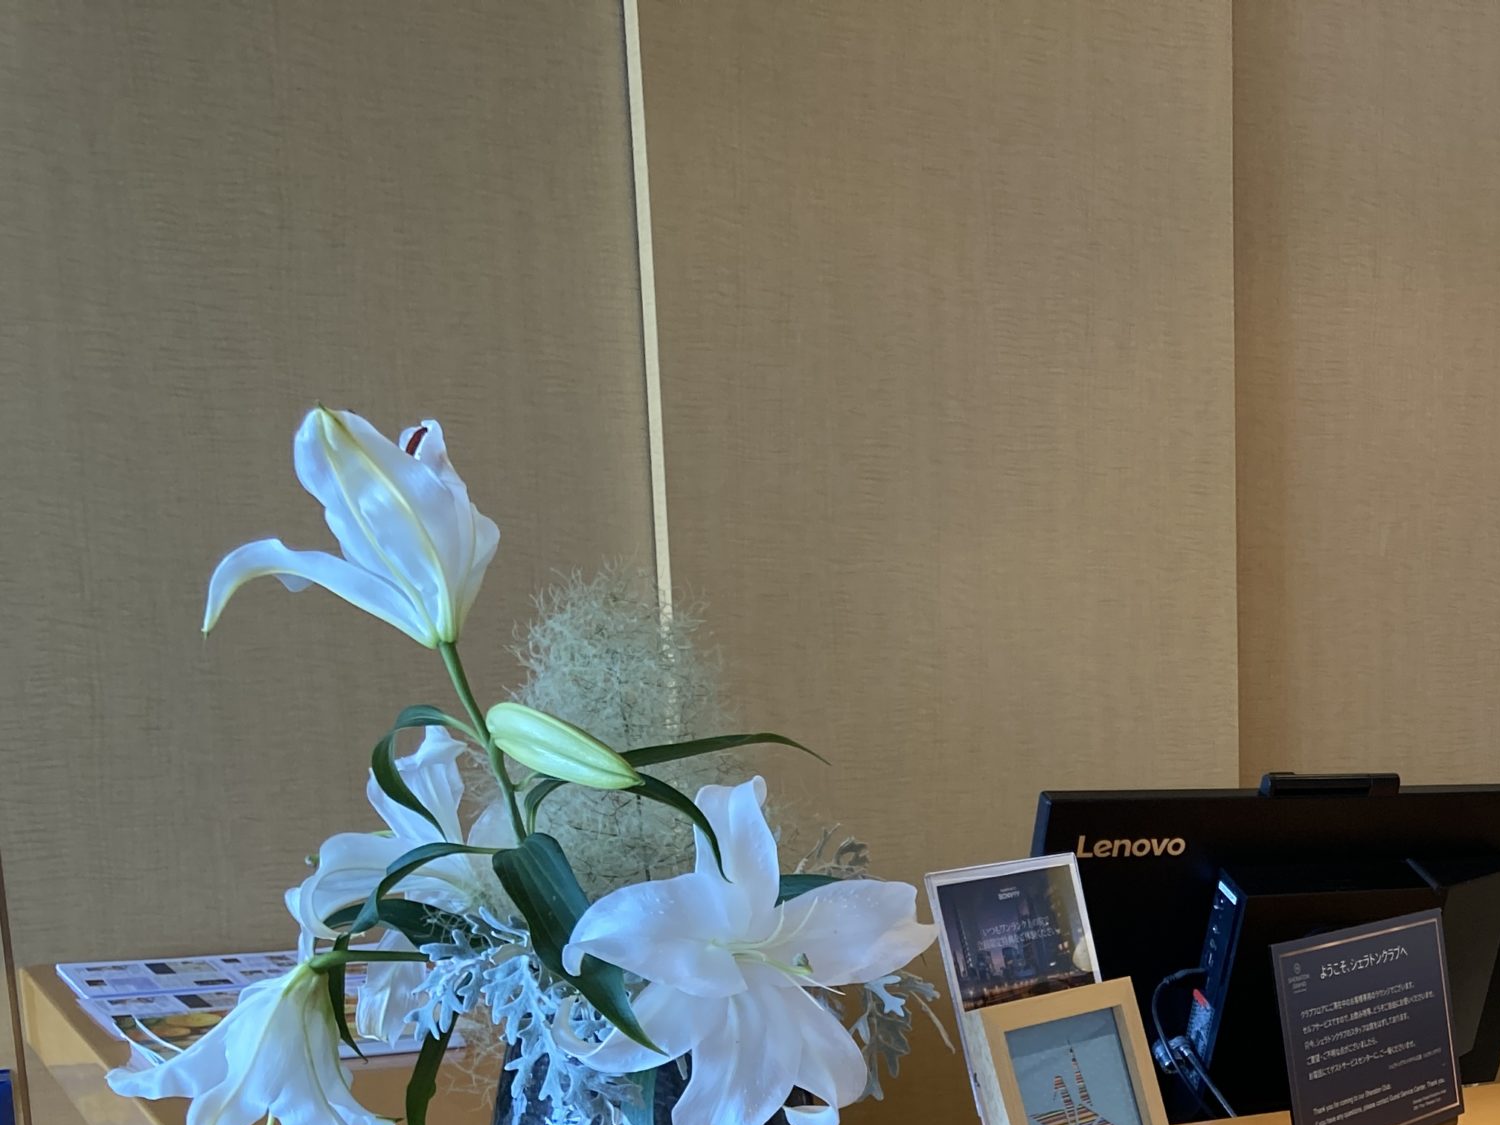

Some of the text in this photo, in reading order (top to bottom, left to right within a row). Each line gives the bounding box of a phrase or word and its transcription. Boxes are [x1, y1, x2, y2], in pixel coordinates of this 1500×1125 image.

[1076, 835, 1187, 859] Lenovo
[1320, 945, 1408, 980] ようこそ、シェラトンクラブへ
